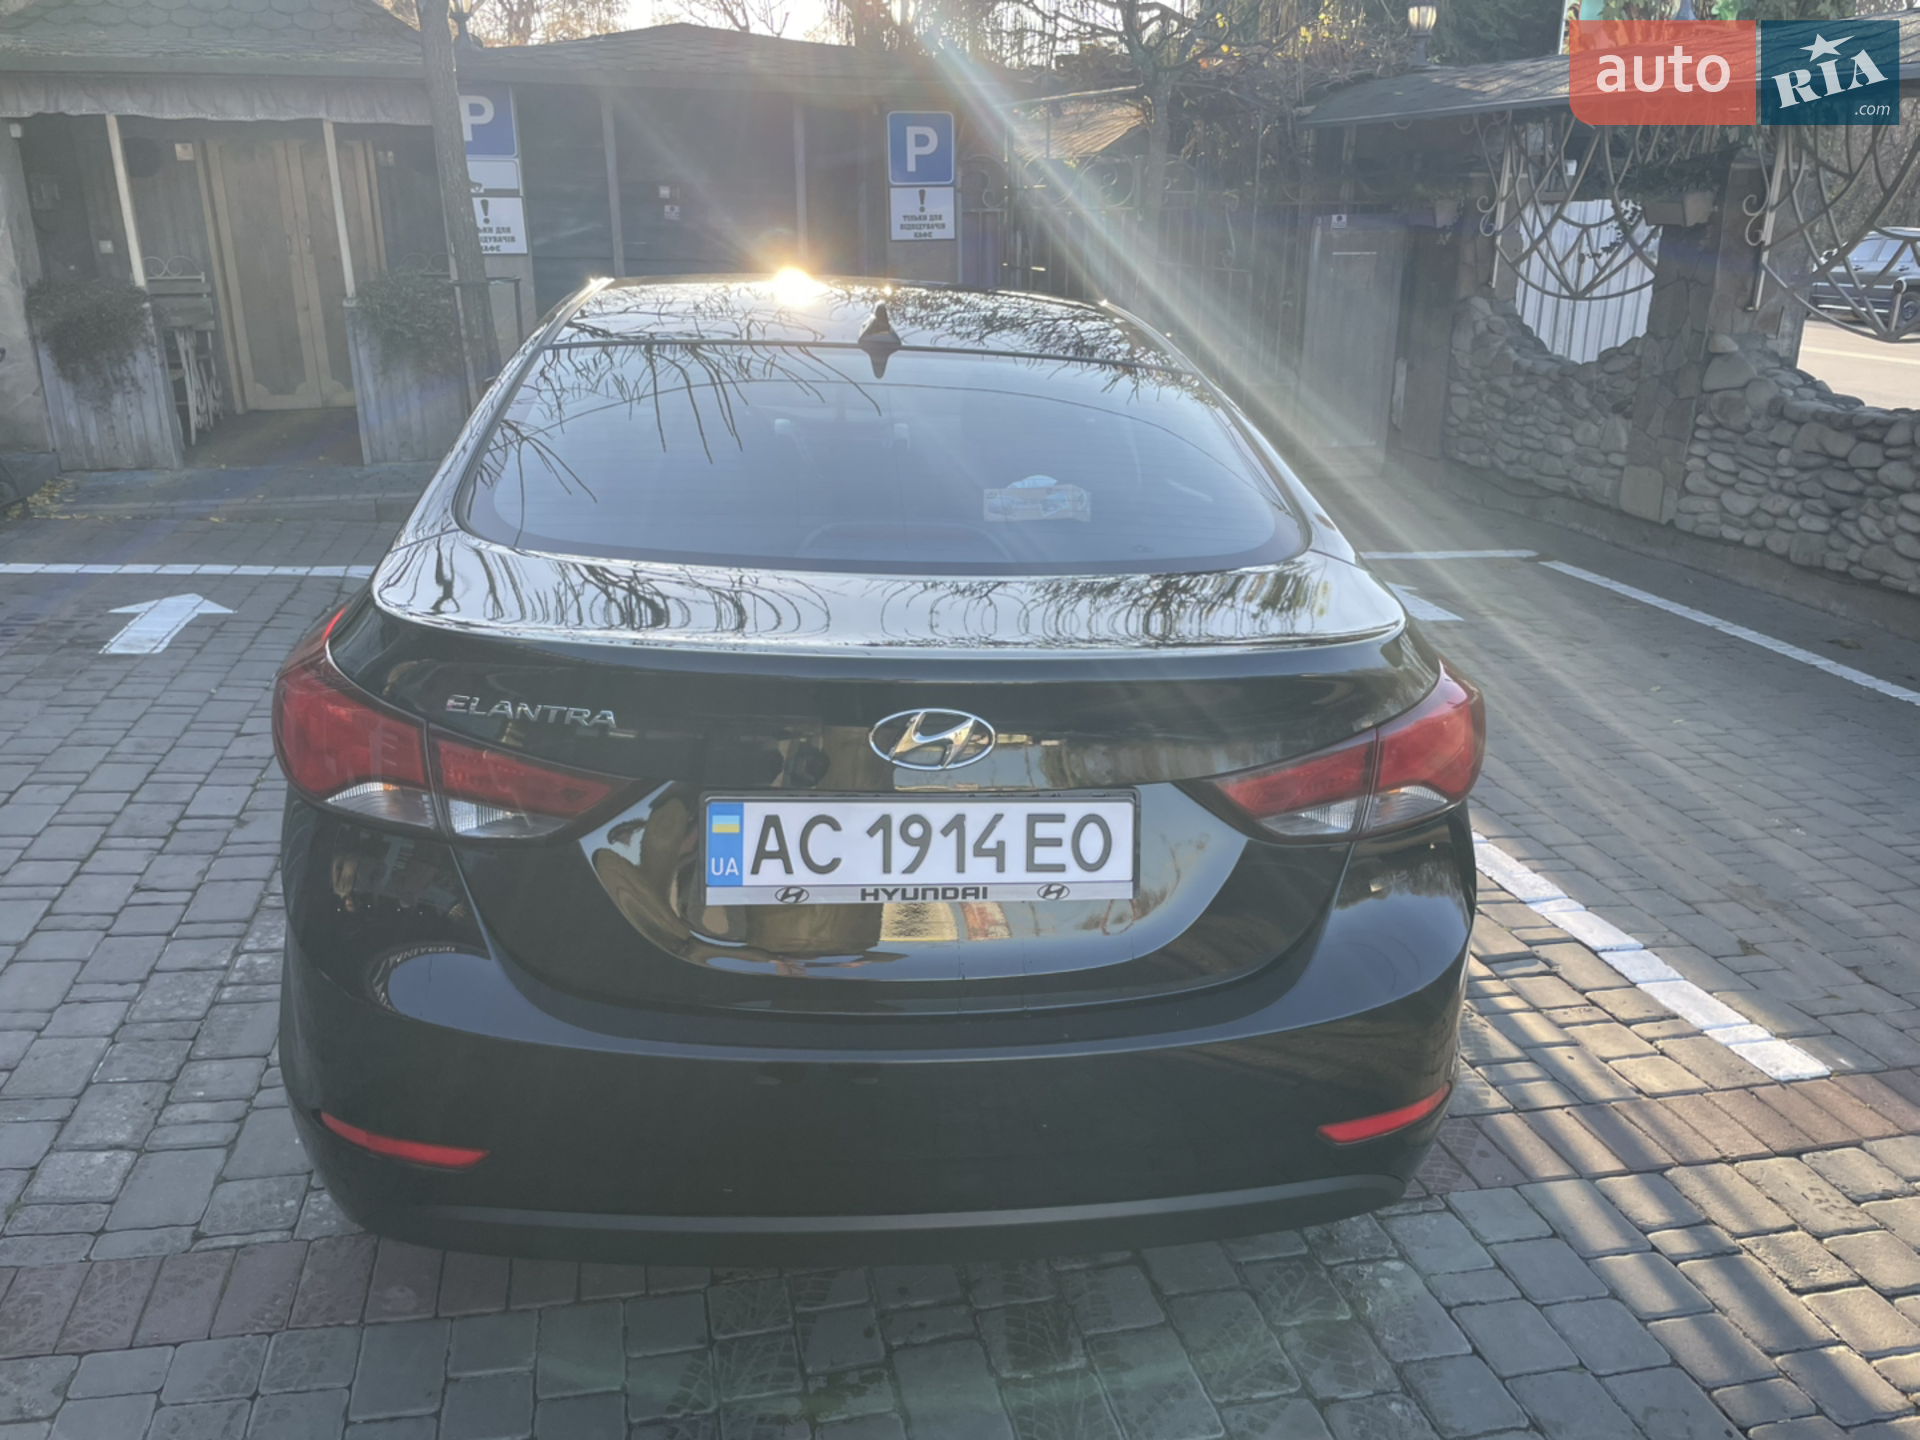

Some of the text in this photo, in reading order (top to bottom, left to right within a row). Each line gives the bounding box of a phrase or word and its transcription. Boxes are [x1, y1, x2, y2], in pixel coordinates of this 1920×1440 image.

[458, 95, 495, 142] P
[906, 126, 938, 172] P
[445, 694, 617, 728] ELANTRA
[750, 814, 842, 875] AC
[866, 813, 1006, 874] 1914
[711, 857, 740, 876] UA
[860, 886, 988, 901] HYUNDAI
